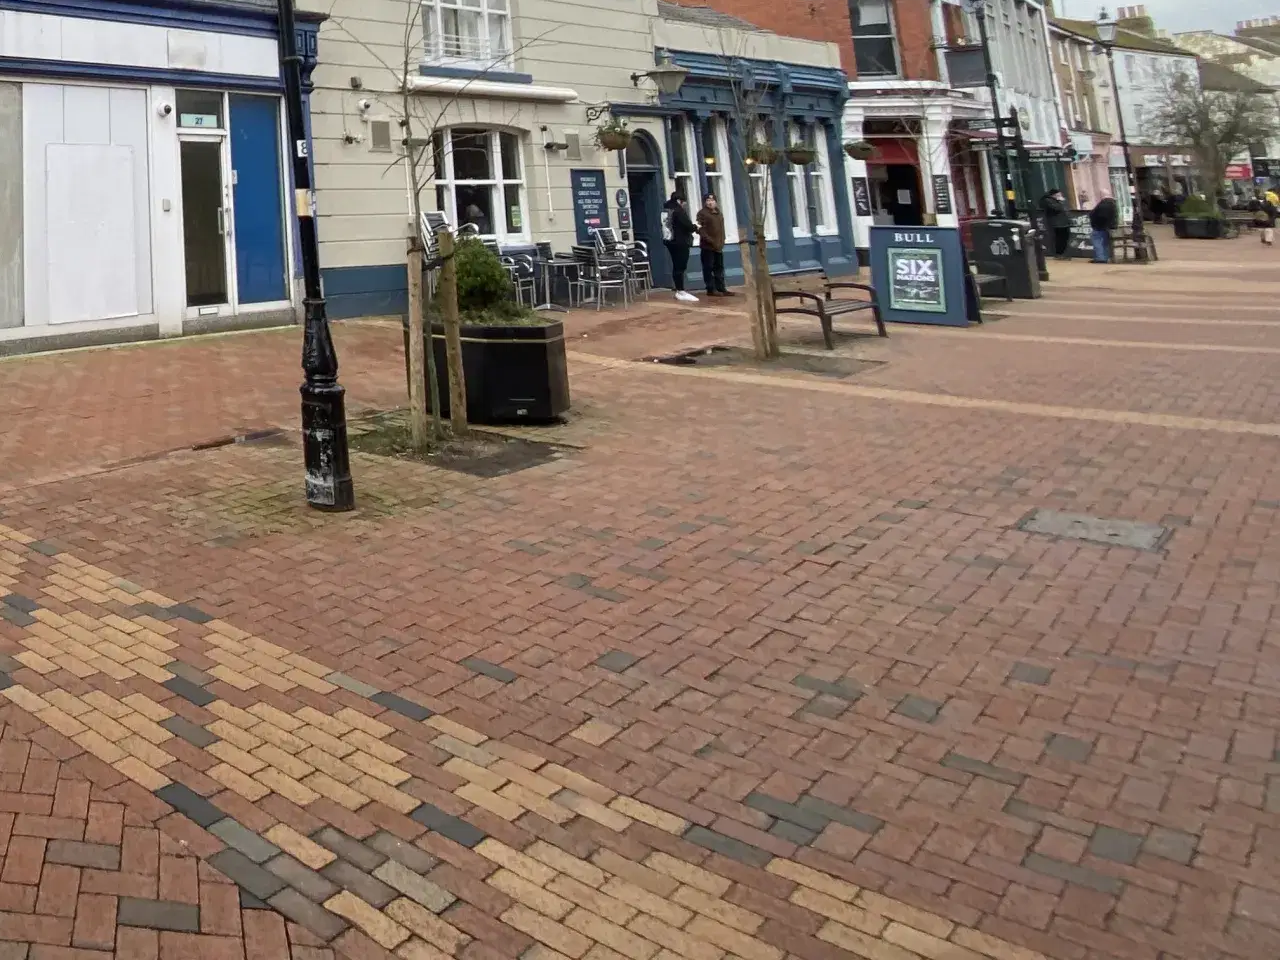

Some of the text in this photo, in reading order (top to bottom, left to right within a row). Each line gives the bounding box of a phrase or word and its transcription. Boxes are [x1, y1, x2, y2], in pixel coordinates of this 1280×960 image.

[194, 117, 203, 125] 27
[894, 232, 934, 243] BULL
[896, 258, 934, 275] SIX
[896, 274, 936, 282] NATIONS
